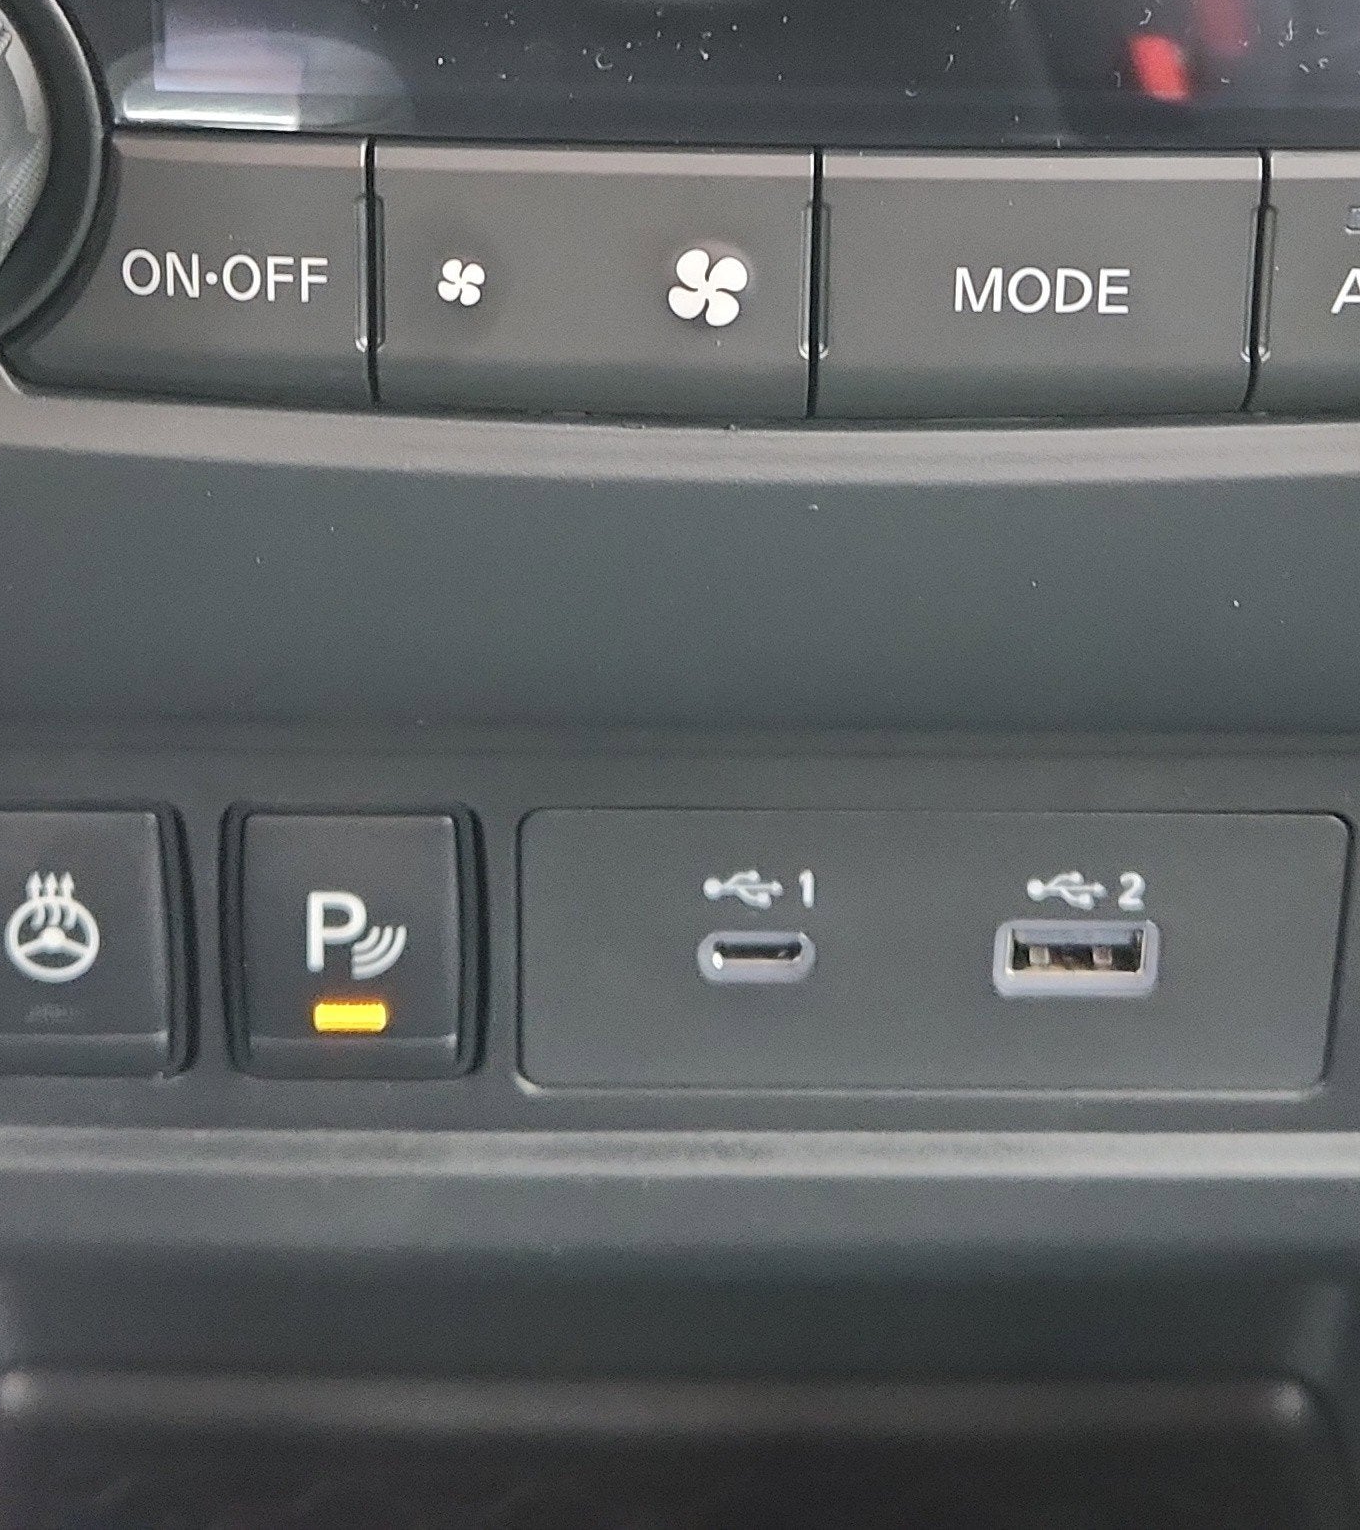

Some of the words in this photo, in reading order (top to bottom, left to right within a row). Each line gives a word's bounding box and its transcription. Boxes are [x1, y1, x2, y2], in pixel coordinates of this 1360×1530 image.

[953, 266, 1131, 315] MODE
[799, 869, 815, 908] 1
[1117, 871, 1146, 911] 2
